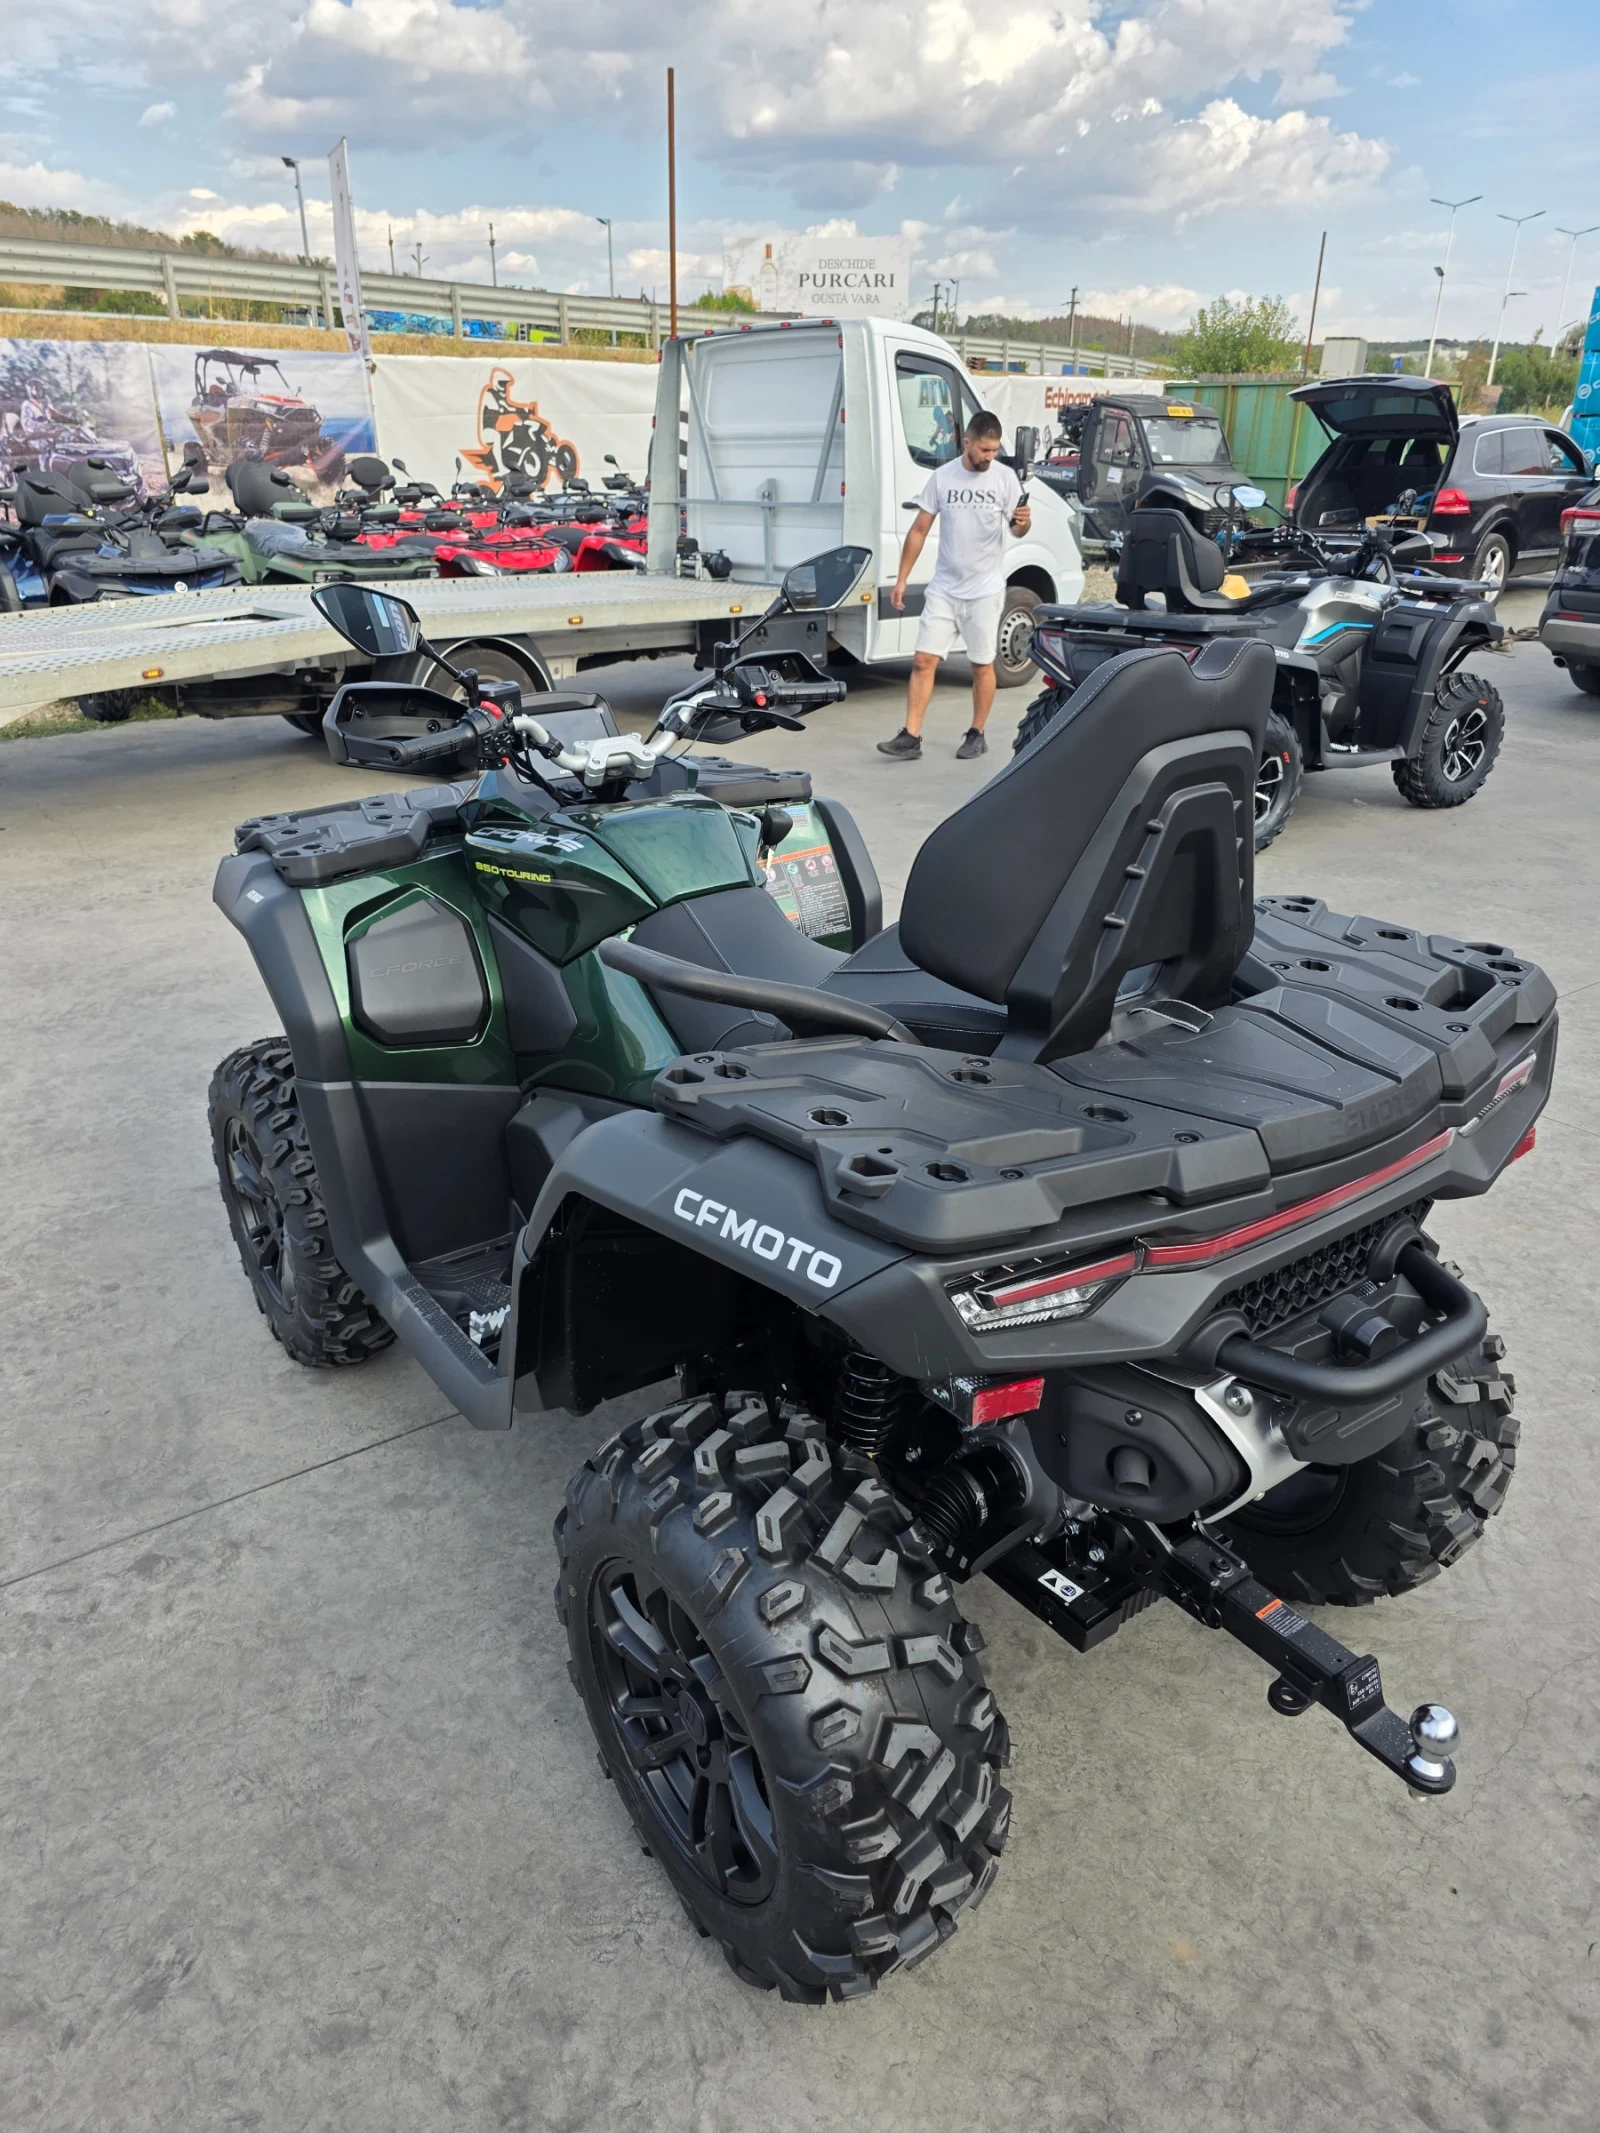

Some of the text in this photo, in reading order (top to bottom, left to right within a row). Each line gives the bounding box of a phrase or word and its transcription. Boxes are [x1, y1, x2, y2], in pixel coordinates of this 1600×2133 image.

[818, 258, 876, 270] DESCHIDE
[799, 273, 895, 288] PURCARI
[851, 293, 880, 304] VARA
[1044, 386, 1116, 409] Echipam
[946, 488, 996, 505] BOSS
[472, 826, 585, 853] CFORCE
[369, 953, 465, 979] CFORCE
[673, 1187, 843, 1289] CFMOTO
